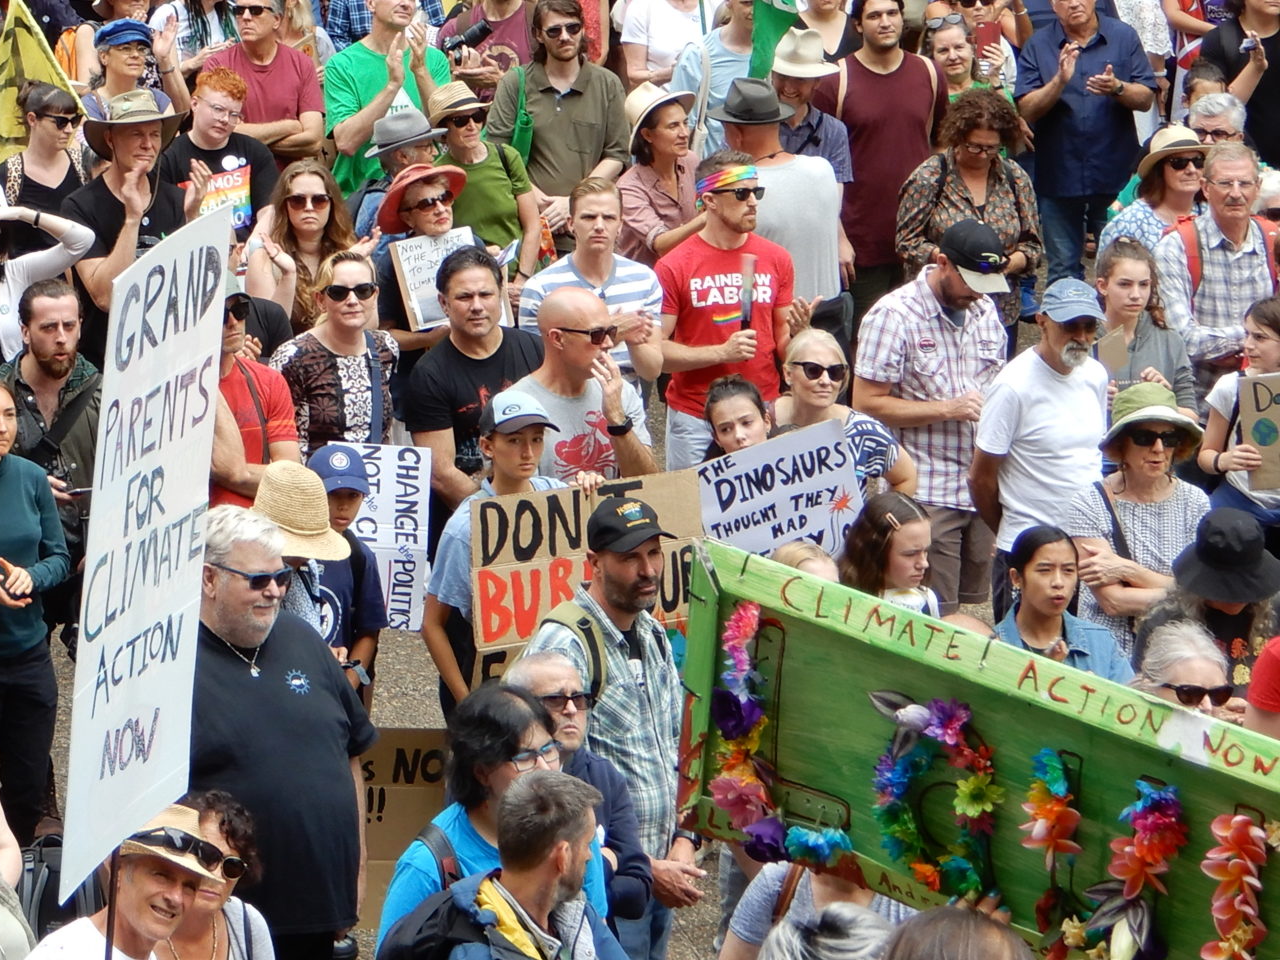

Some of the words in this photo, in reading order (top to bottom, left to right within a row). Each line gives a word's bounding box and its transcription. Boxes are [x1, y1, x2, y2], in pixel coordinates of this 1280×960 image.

[403, 252, 426, 266] THE
[408, 263, 423, 276] TO
[689, 272, 771, 291] RAINBW
[114, 245, 222, 373] GRAND
[99, 355, 215, 491] PARENTS
[123, 464, 166, 539] FOR
[393, 446, 422, 545] CHANGE
[698, 454, 737, 486] THE
[714, 441, 847, 514] DINOSAURS
[710, 502, 778, 540] THOUGHT
[790, 485, 839, 512] THEY
[83, 498, 209, 644] CLIMATE
[388, 559, 417, 631] POLITICS
[478, 557, 595, 644] BUR
[90, 613, 184, 720] ACTION
[99, 707, 161, 781] NOW
[1016, 659, 1168, 737] ACTION
[1203, 726, 1280, 777] NOW
